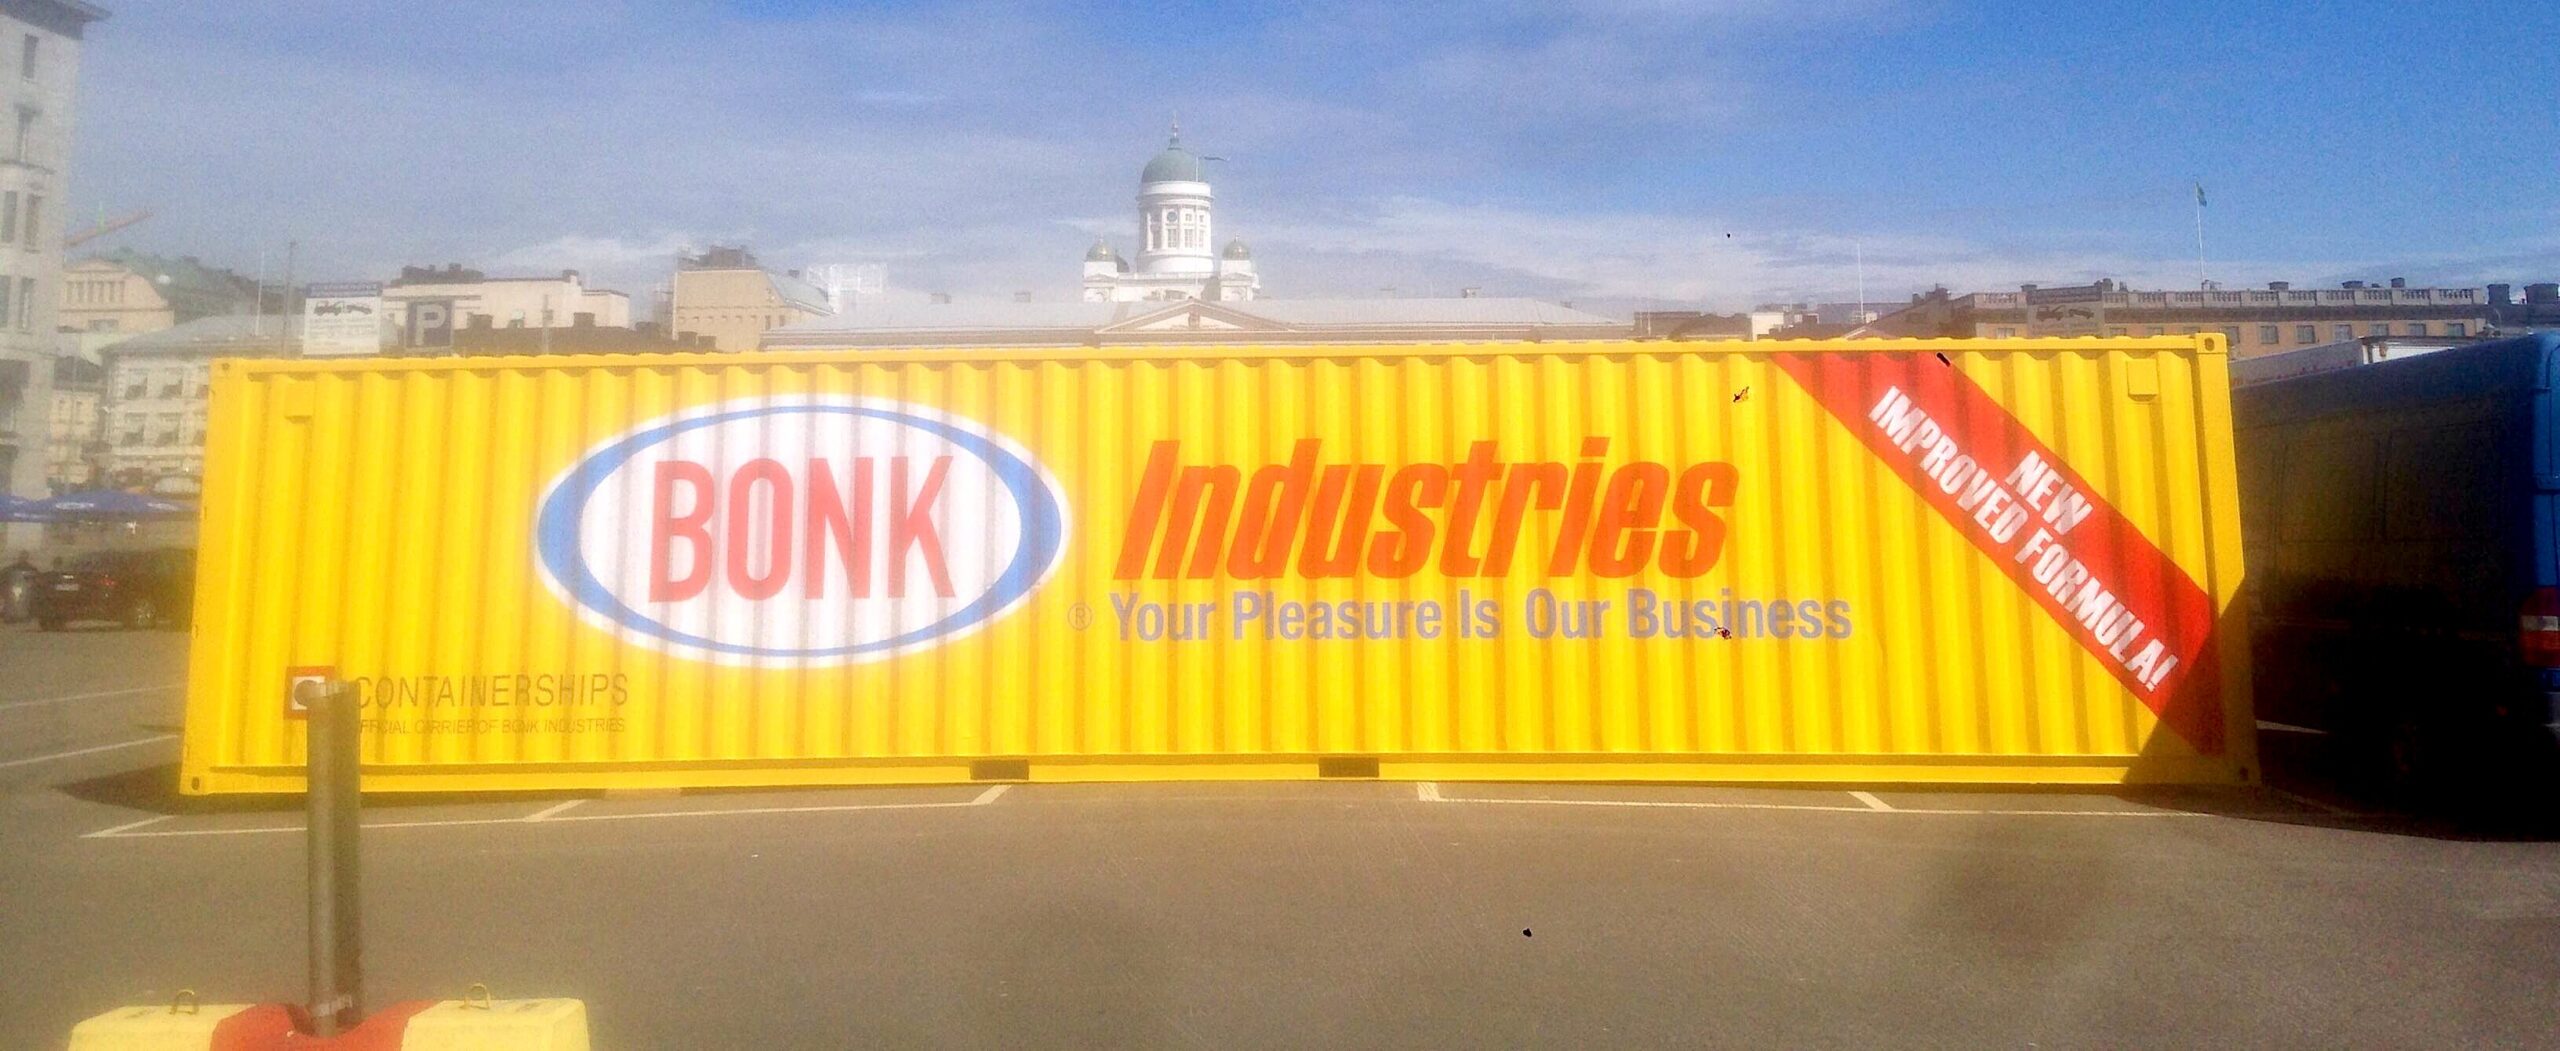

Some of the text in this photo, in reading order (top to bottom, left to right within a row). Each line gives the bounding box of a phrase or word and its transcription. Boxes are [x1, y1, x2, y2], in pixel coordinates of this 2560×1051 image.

[415, 303, 446, 346] P
[1112, 436, 1739, 581] Industries
[2005, 450, 2095, 536] NEW
[648, 455, 957, 603] BONK
[1867, 385, 2179, 692] IMPROVED FORMULA!
[1109, 587, 1853, 641] Your Pleasure Is Our Business
[355, 672, 628, 708] CONTAINERSHIPS
[478, 719, 500, 735] OF
[544, 717, 626, 734] INDUSTRIES
